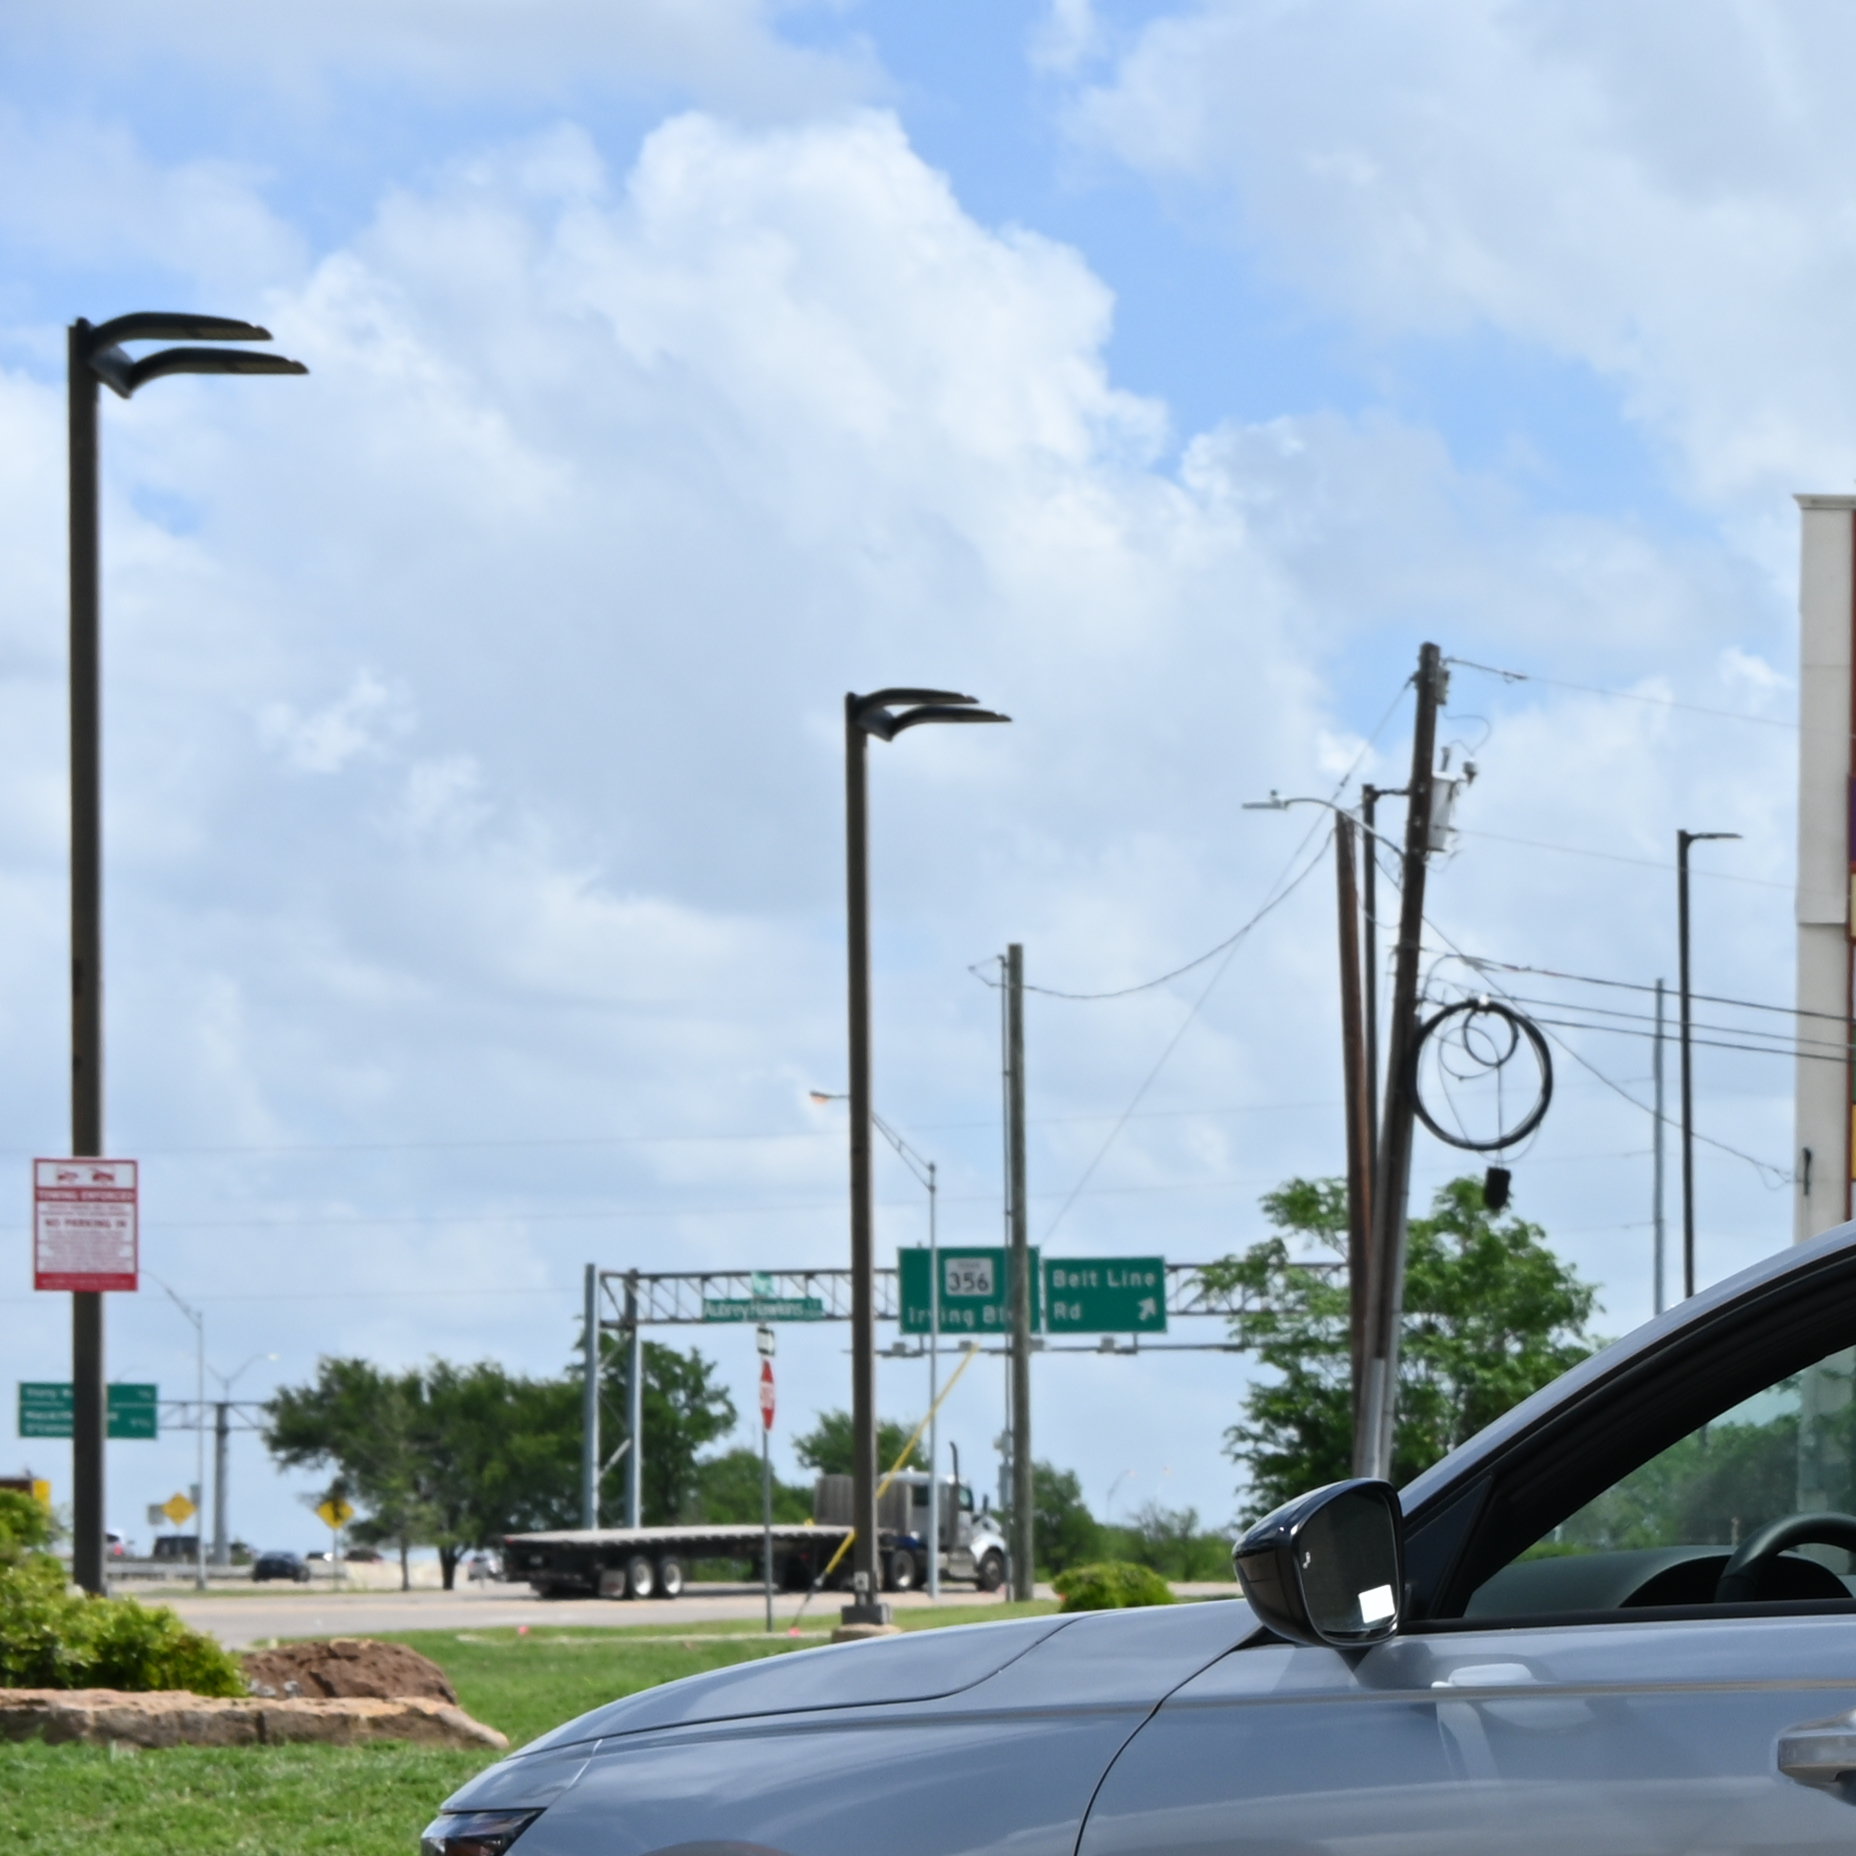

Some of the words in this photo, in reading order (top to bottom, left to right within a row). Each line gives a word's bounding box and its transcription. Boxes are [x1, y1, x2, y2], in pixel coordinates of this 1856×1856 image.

[64, 1219, 112, 1228] PARKING
[948, 1271, 989, 1292] 356
[1052, 1269, 1098, 1288] Belt
[1106, 1269, 1157, 1288] Line
[1053, 1301, 1082, 1320] Rd
